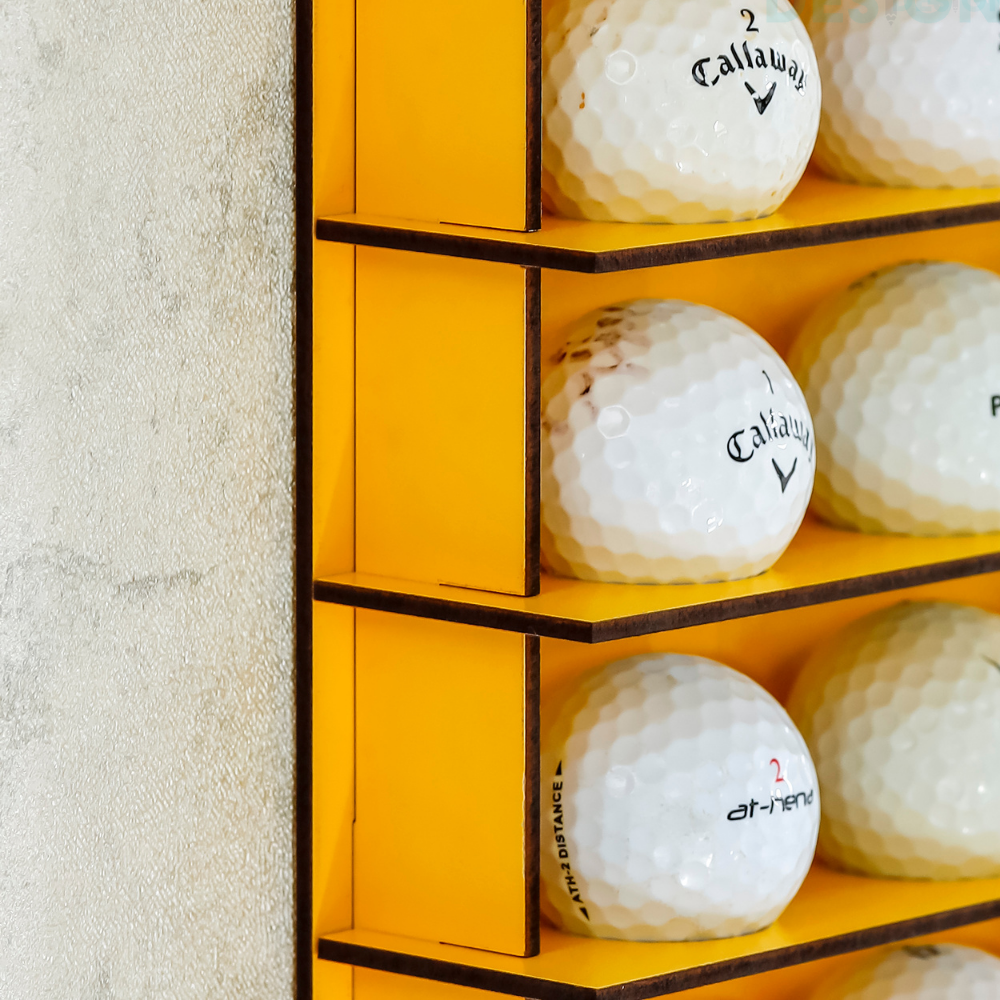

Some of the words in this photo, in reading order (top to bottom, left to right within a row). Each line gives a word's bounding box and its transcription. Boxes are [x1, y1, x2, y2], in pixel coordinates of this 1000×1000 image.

[740, 8, 760, 33] 2
[691, 40, 805, 92] Callaway
[761, 369, 775, 395] 1
[769, 757, 785, 783] 2
[552, 780, 570, 859] DISTANCE
[561, 862, 585, 905] ATH-2
